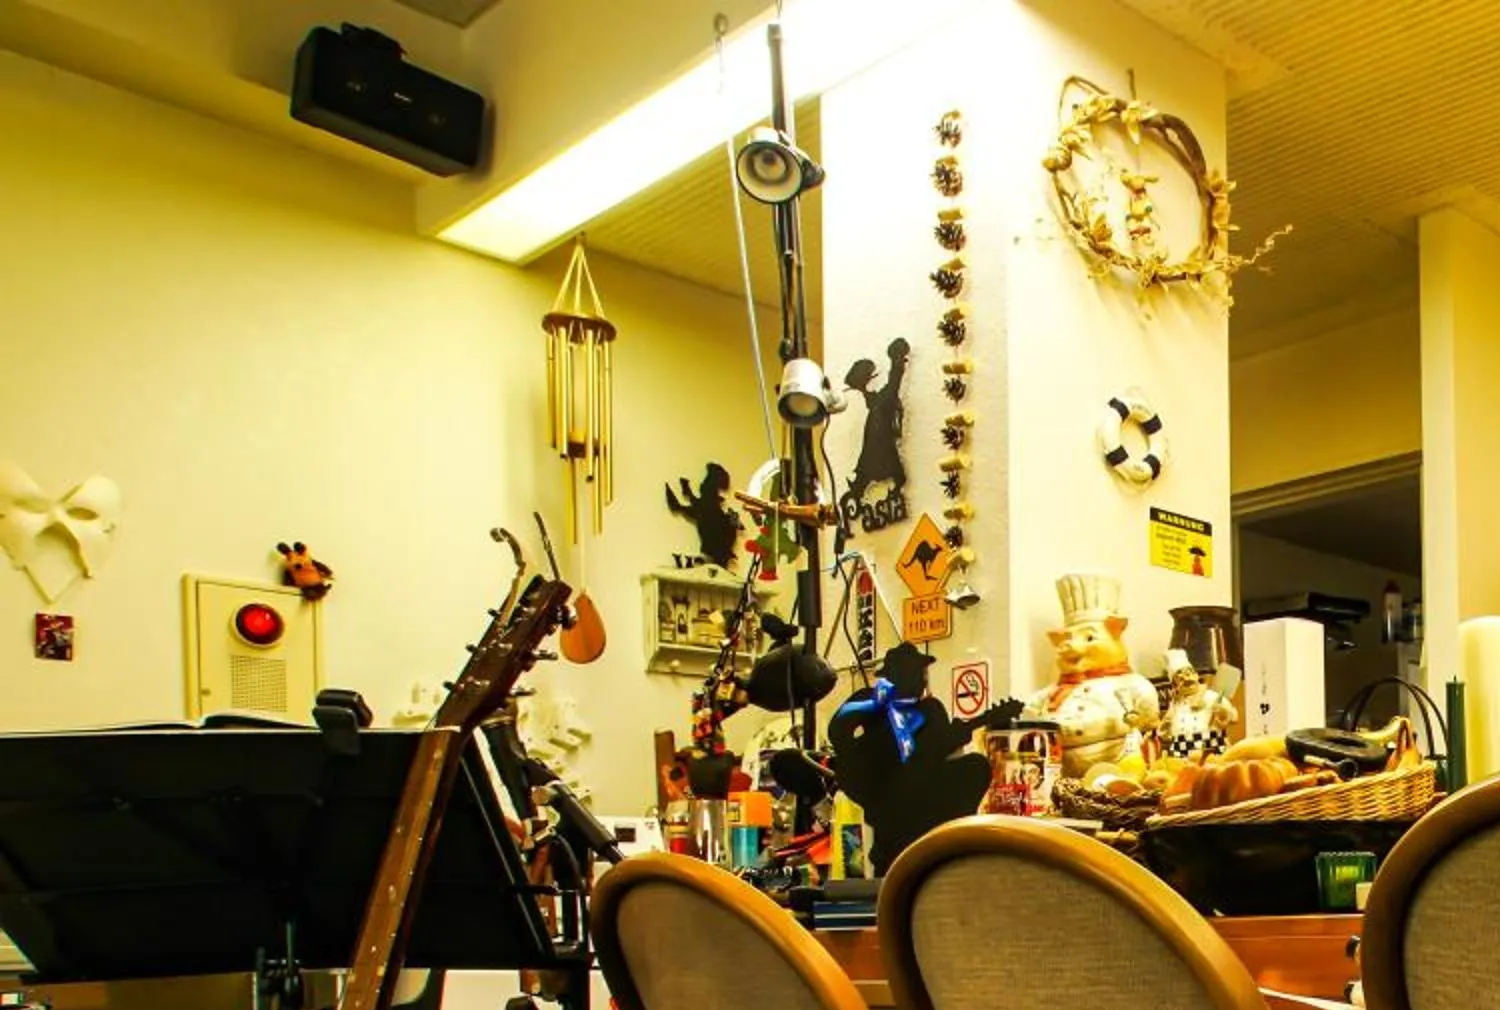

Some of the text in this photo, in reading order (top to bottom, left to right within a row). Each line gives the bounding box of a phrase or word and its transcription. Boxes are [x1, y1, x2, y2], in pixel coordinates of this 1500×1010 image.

[840, 490, 908, 538] Pasta
[911, 598, 940, 615] NEXT
[909, 619, 927, 633] 110
